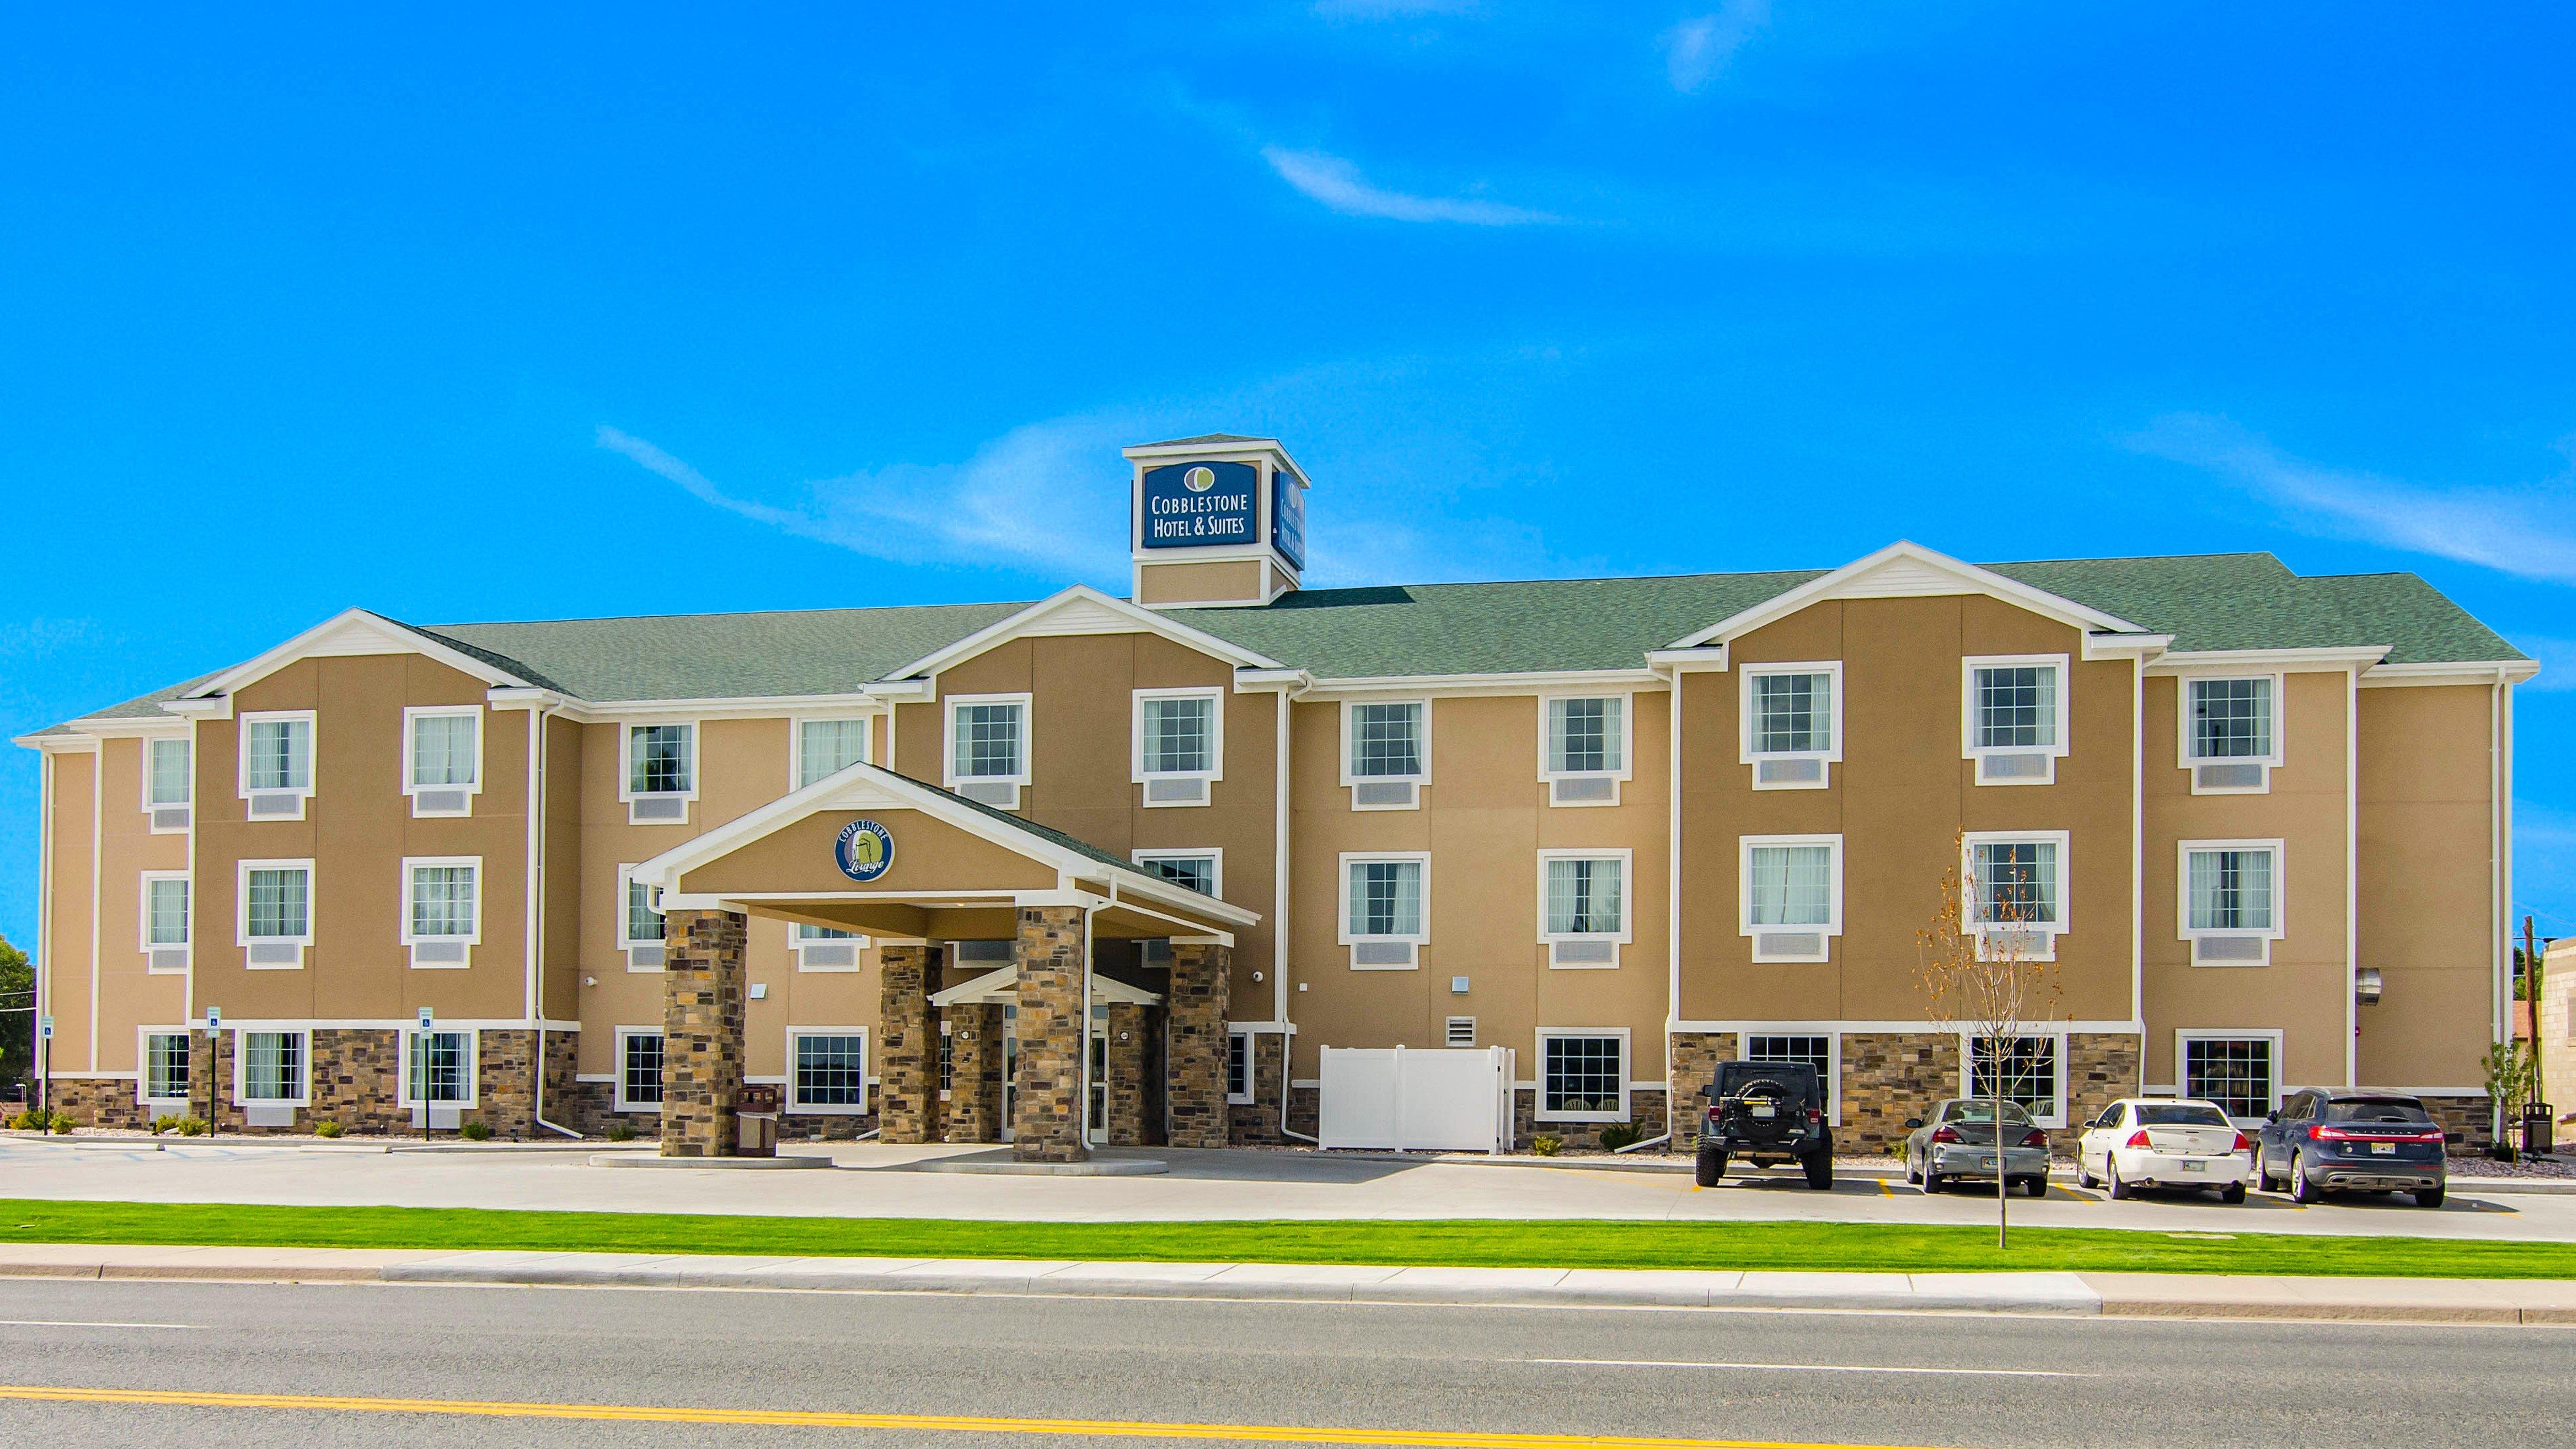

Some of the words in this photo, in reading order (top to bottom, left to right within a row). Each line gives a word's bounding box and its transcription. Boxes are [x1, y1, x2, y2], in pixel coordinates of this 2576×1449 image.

[1152, 494, 1247, 515] COBBLESTONE
[1154, 519, 1192, 538] HOTEL
[1194, 516, 1204, 535] &
[1208, 515, 1244, 535] SUITES
[839, 821, 888, 842] COBBLESTONE
[846, 859, 884, 874] Lounge
